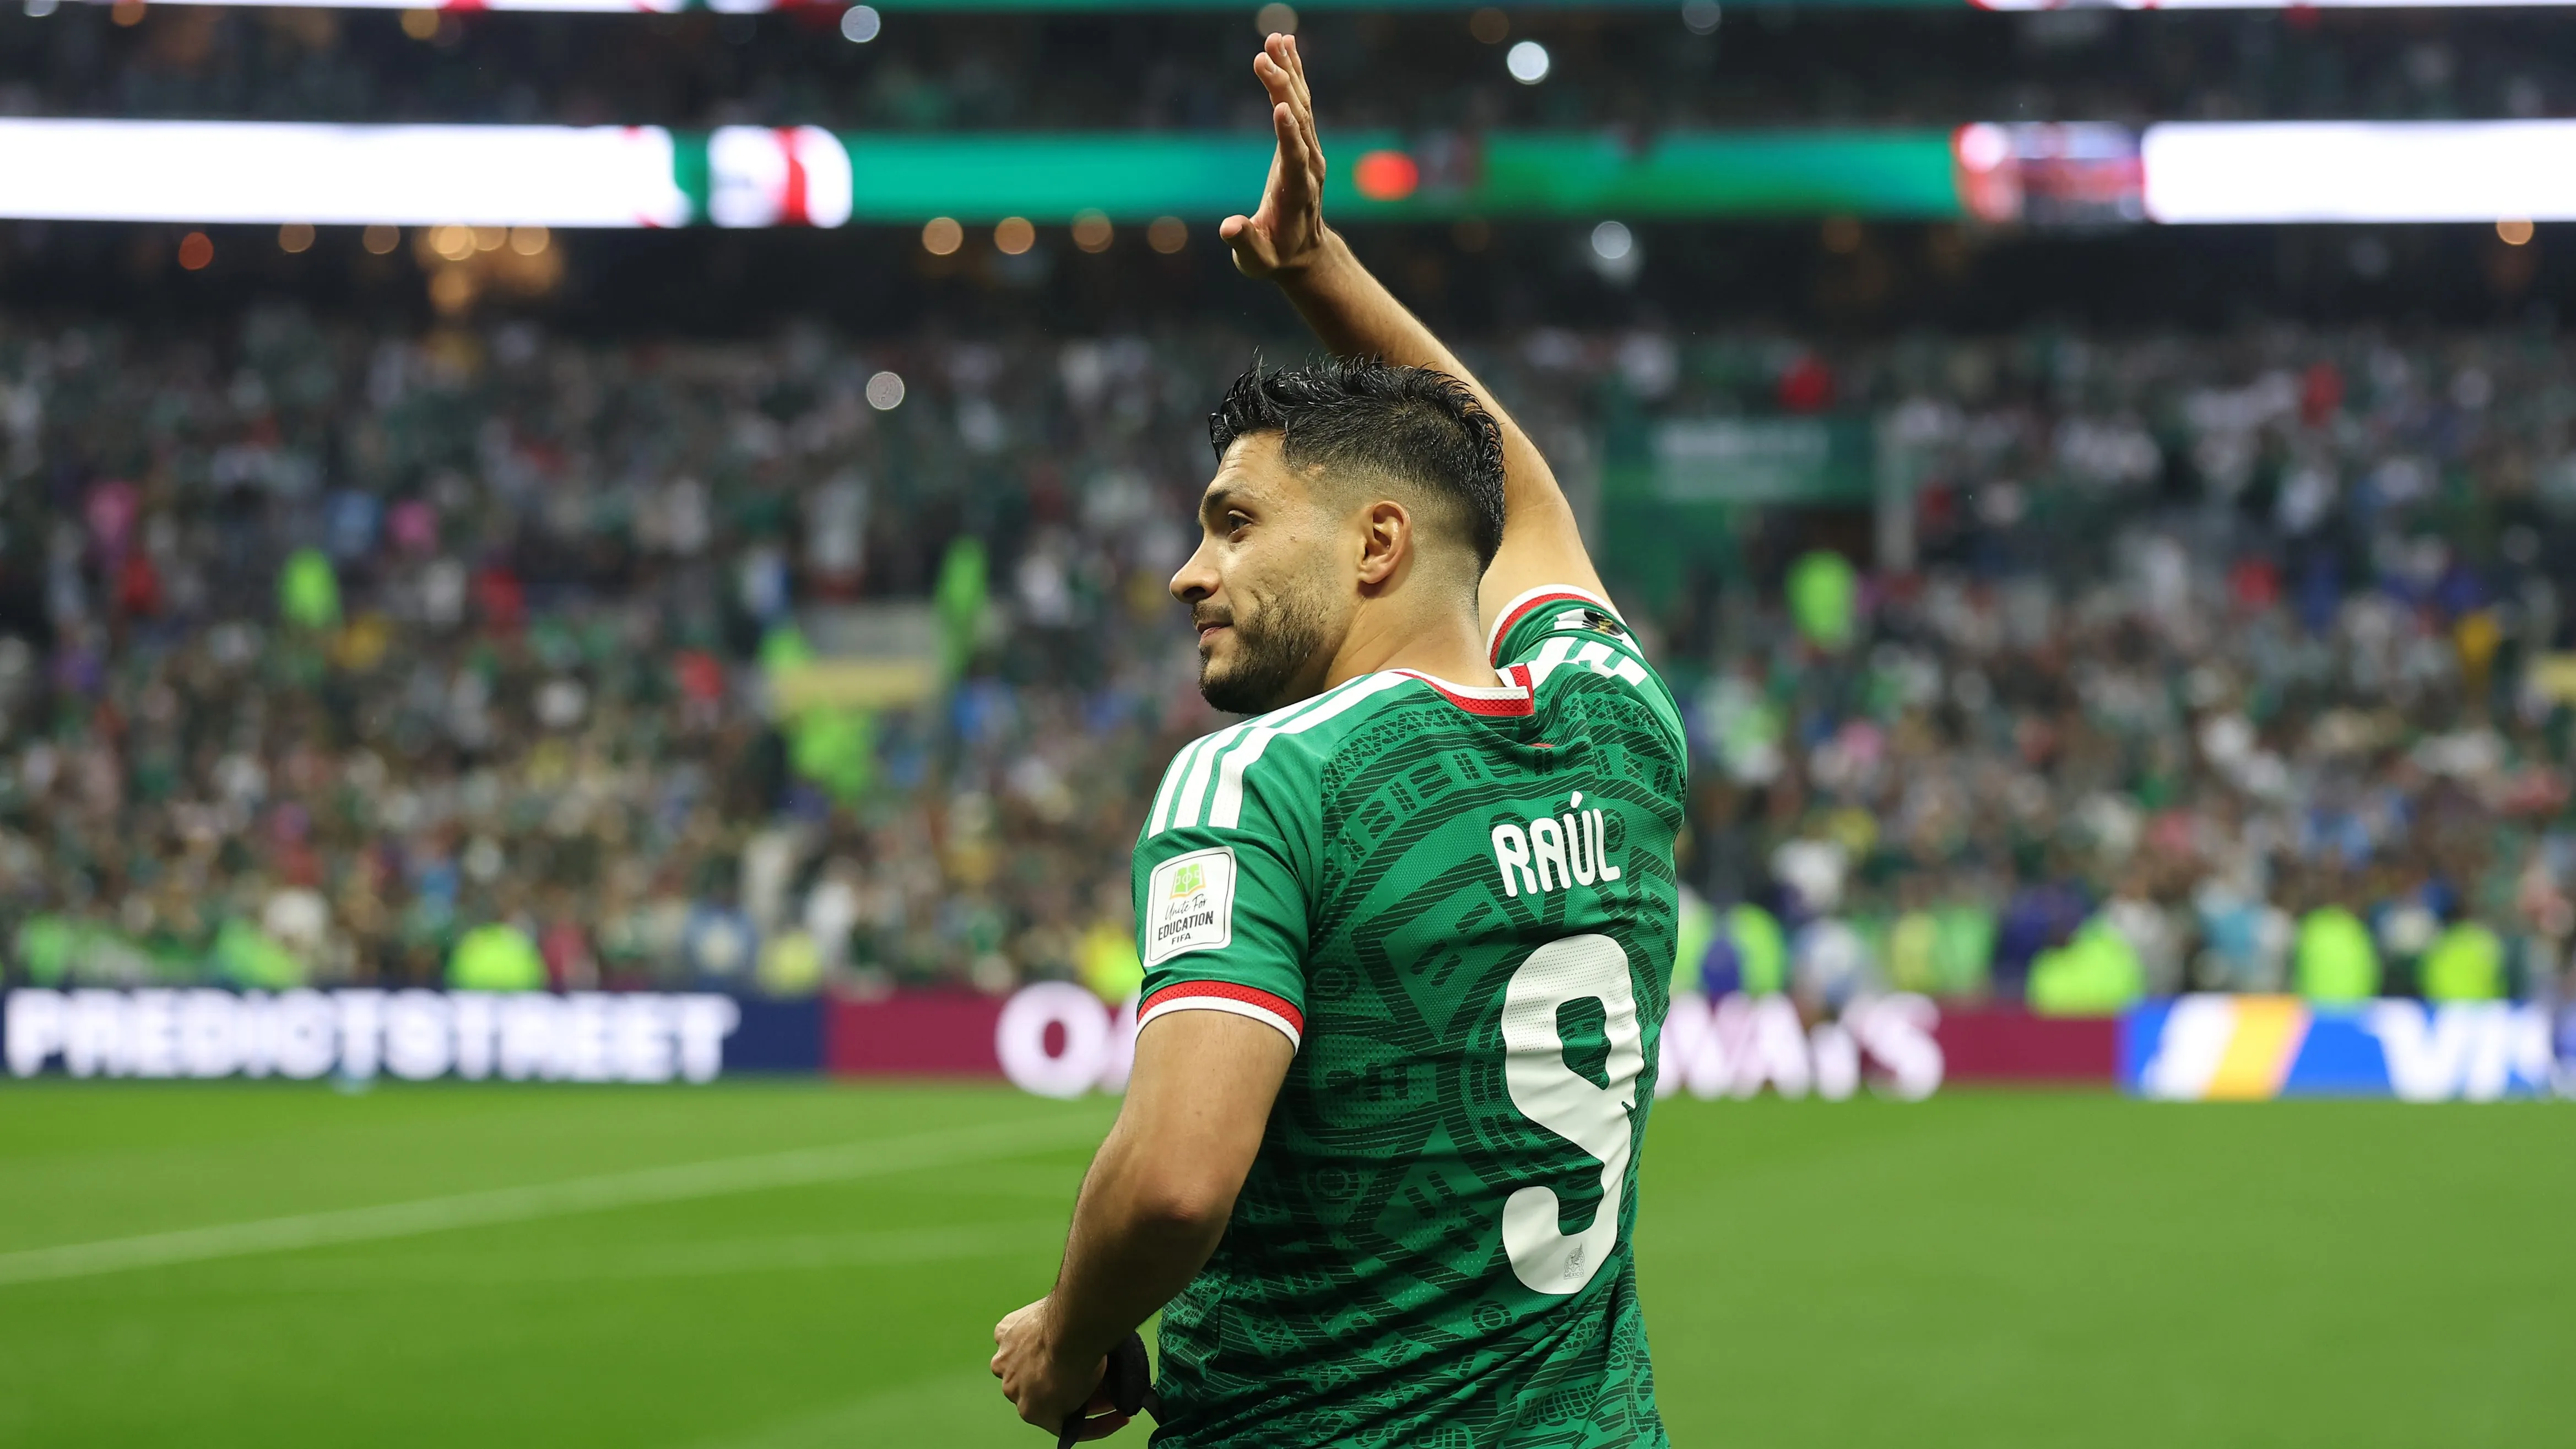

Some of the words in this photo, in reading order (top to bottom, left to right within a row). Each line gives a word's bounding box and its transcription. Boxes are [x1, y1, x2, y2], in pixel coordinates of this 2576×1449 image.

[1491, 791, 1621, 897] RAÚL
[1165, 901, 1191, 921] Unite
[1192, 894, 1208, 911] For
[1158, 911, 1214, 941] EDUCATION
[1172, 933, 1191, 945] FIFA
[1501, 934, 1644, 1294] 9
